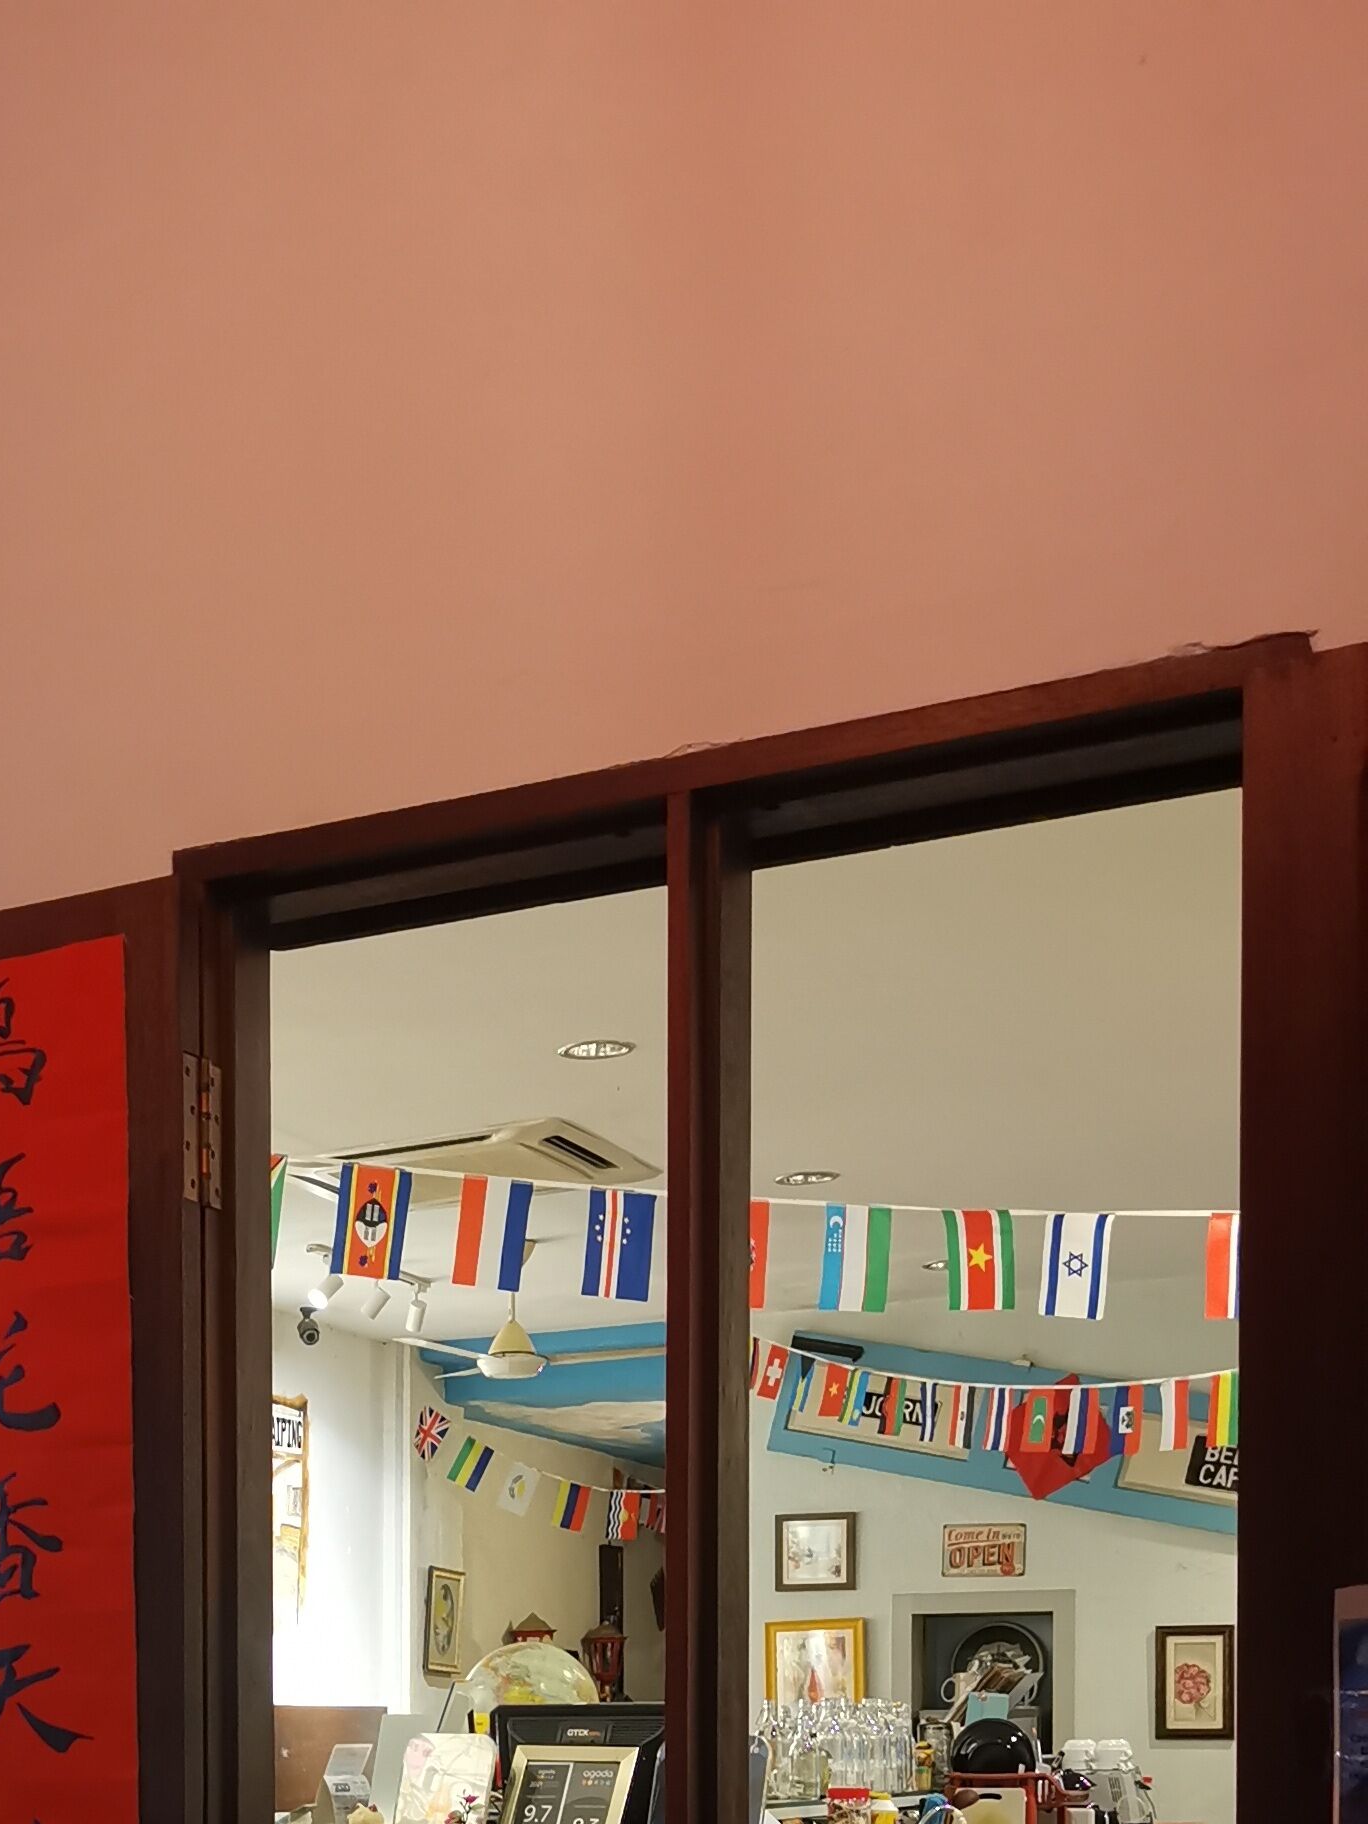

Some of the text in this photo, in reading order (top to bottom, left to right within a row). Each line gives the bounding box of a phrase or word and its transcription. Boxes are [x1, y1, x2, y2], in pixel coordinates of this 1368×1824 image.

[1199, 1464, 1239, 1488] CAF
[949, 1542, 1016, 1569] OPEN
[582, 1769, 614, 1779] agoda
[523, 1804, 553, 1823] 9.7
